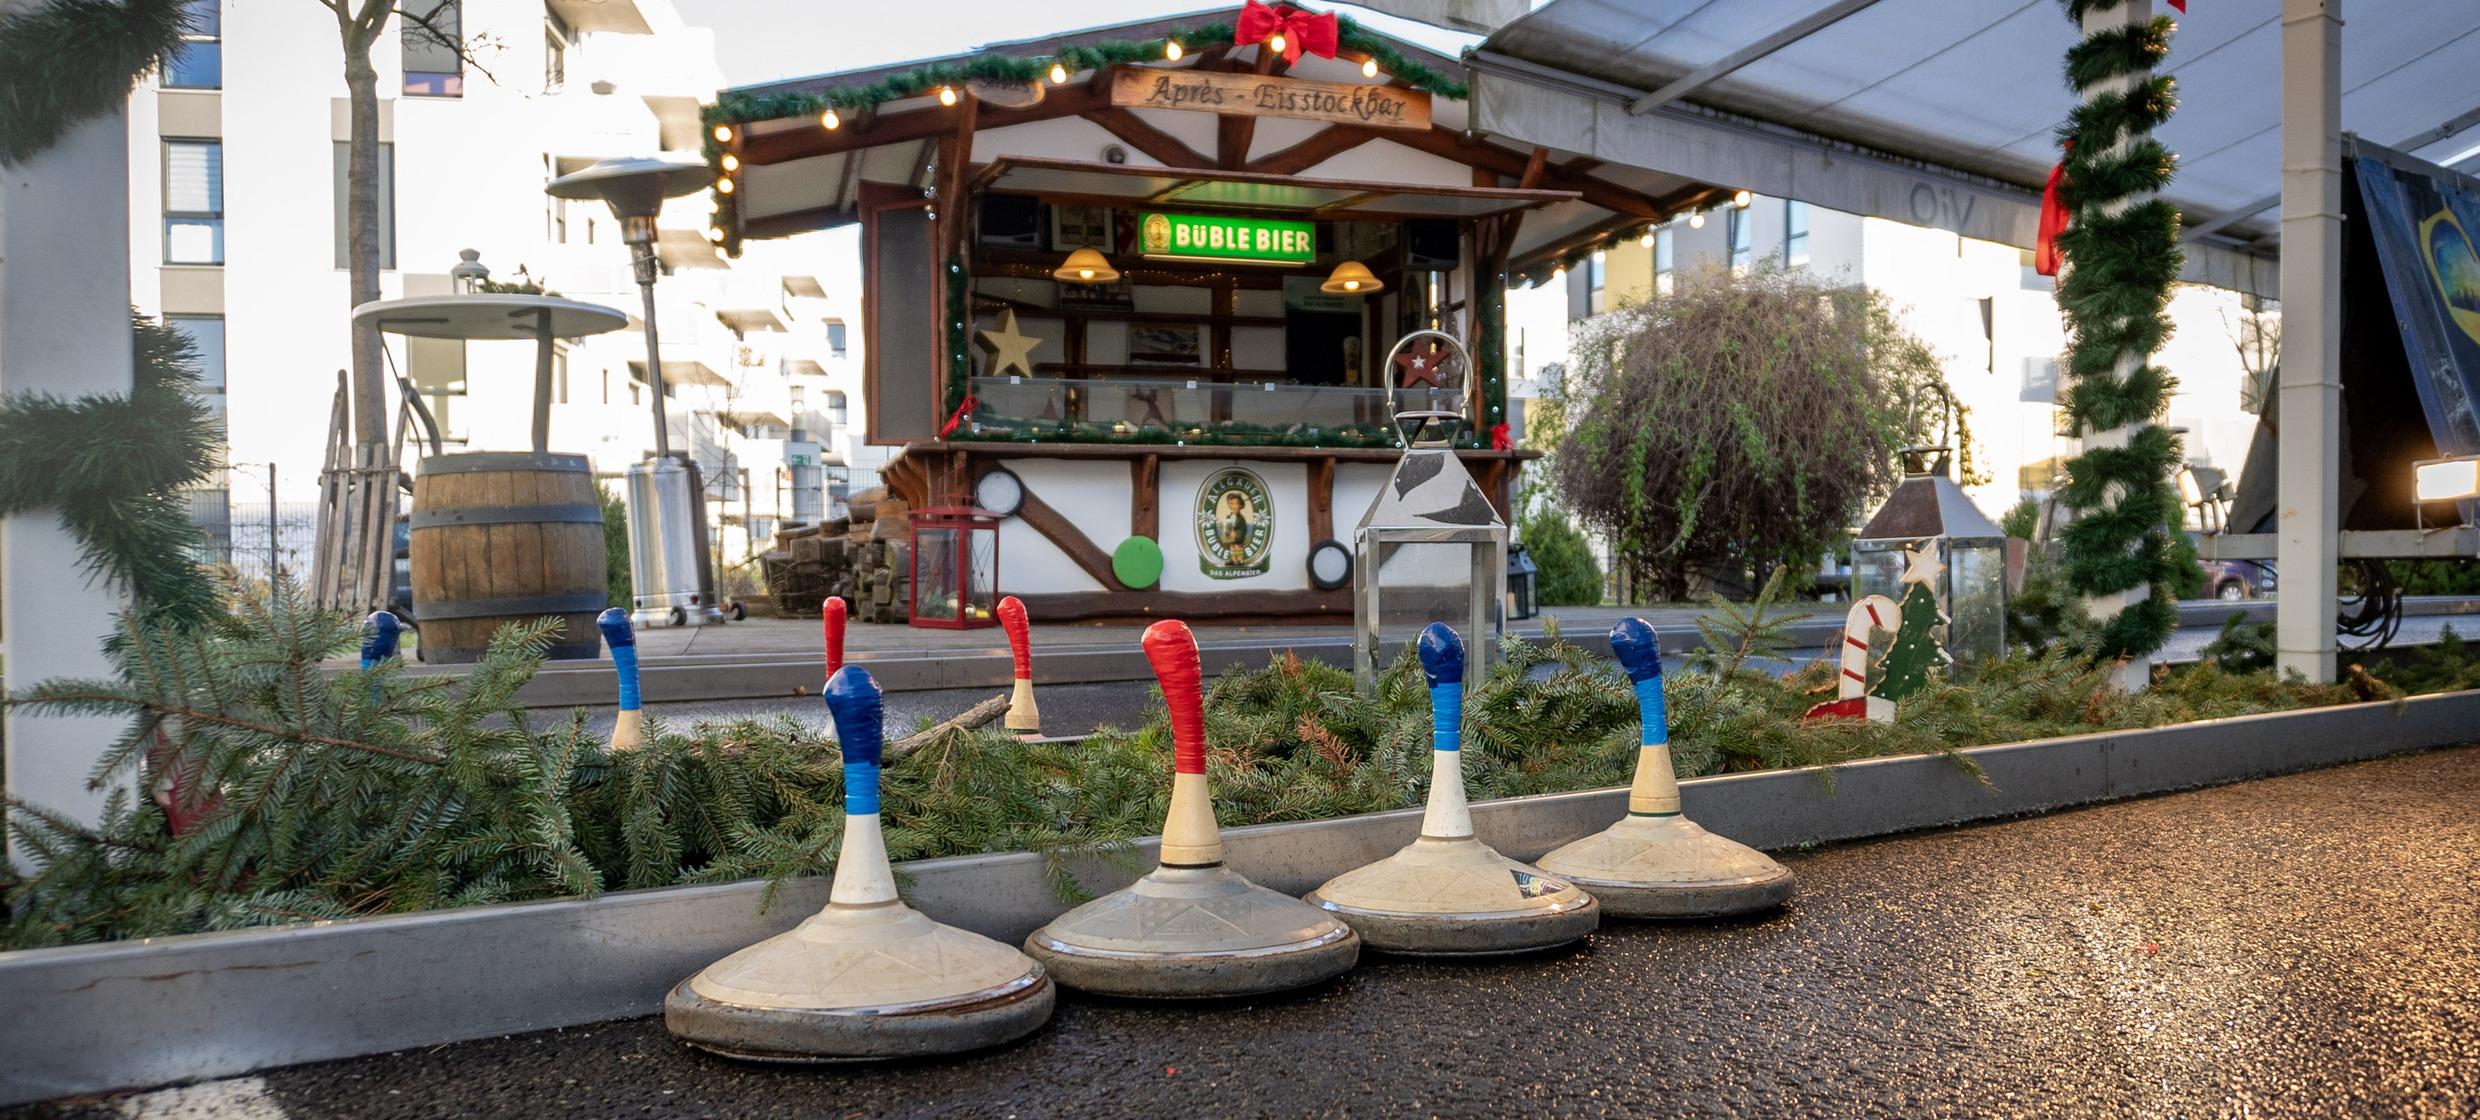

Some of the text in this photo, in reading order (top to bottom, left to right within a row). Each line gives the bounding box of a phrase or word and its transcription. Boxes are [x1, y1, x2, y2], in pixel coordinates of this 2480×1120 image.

[1146, 75, 1224, 106] Après
[1254, 83, 1406, 121] Eisstockbar
[1175, 223, 1250, 249] BÜBLE
[1256, 228, 1311, 252] BIER
[1244, 529, 1264, 557] BIER
